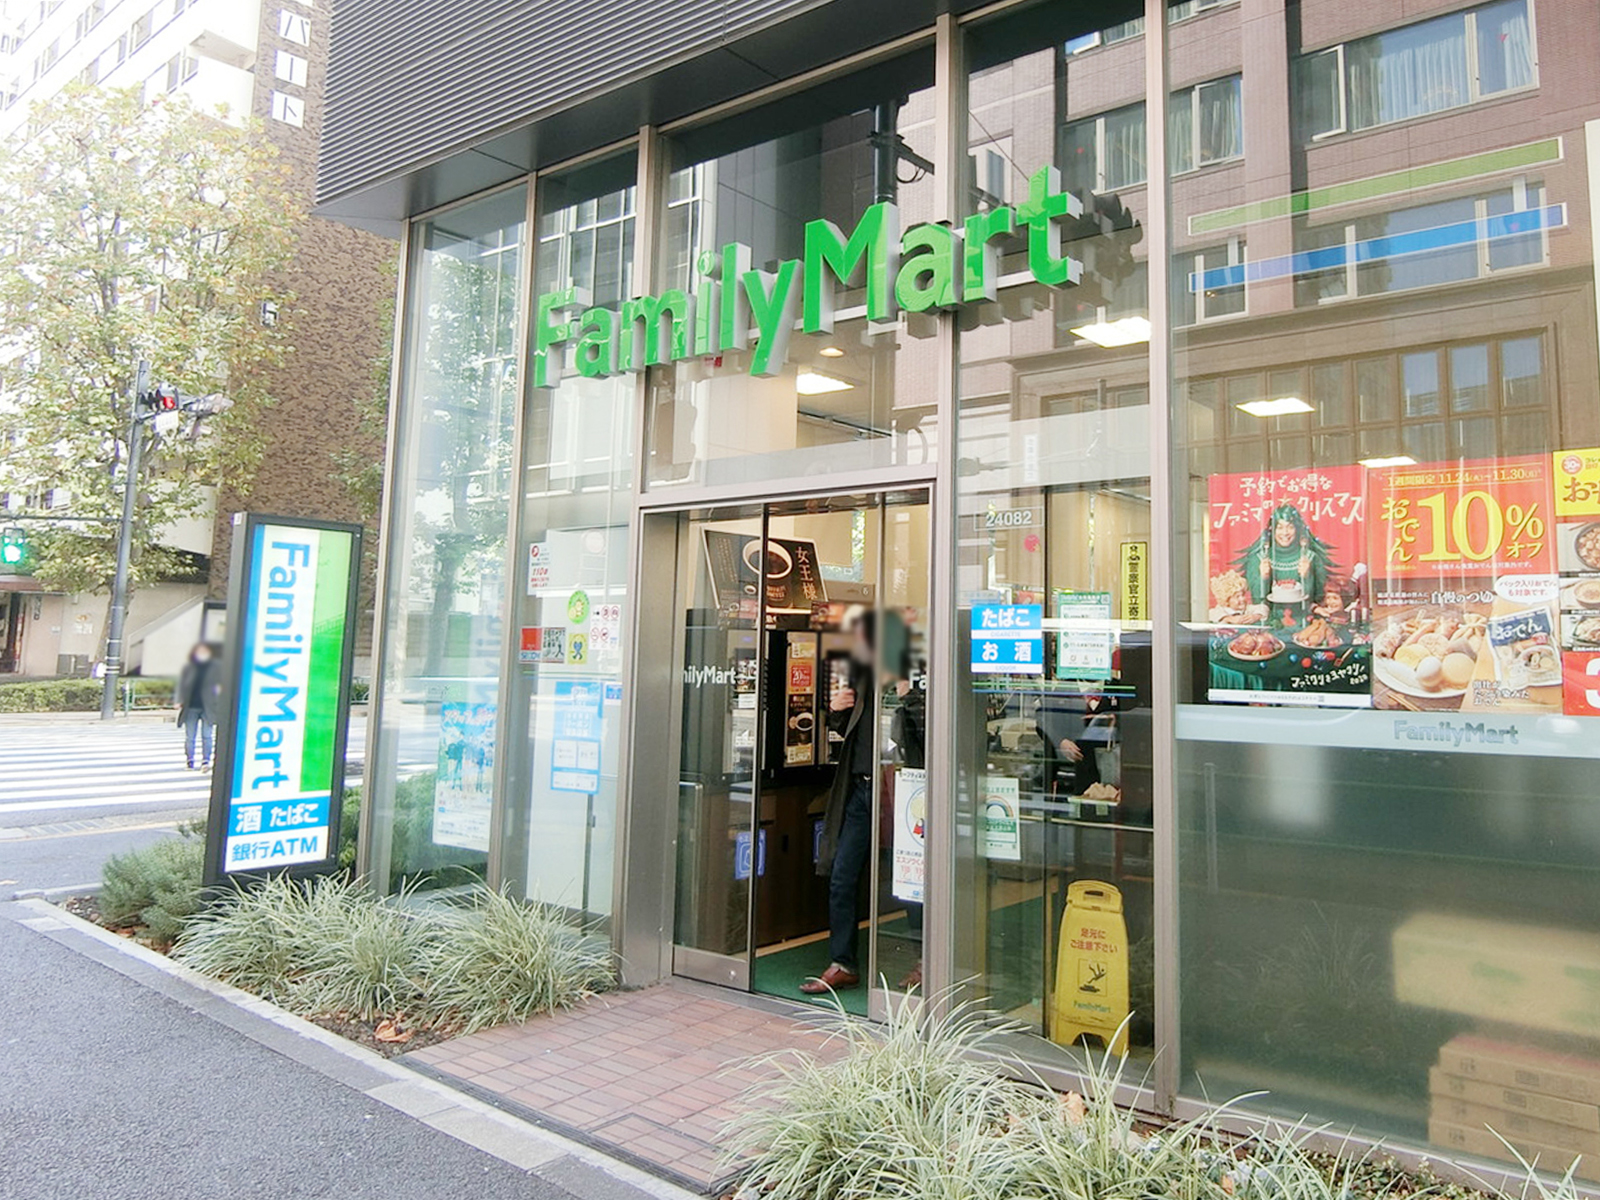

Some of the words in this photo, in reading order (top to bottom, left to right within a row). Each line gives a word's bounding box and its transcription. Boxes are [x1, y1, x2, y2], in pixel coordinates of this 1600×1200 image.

[533, 165, 1083, 389] FamilyMart
[1239, 473, 1333, 498] 予約でお得な
[1562, 476, 1600, 503] お
[986, 511, 1032, 528] 24082
[1381, 496, 1421, 563] おでん
[1506, 541, 1544, 559] オフ
[794, 545, 819, 601] 女王様
[981, 607, 1031, 628] たばこ
[1495, 618, 1544, 642] おでん
[251, 540, 311, 791] FamilyMart
[1393, 719, 1520, 747] FamilyMart
[234, 804, 264, 833] 酒
[268, 802, 320, 828] たばこ
[231, 835, 319, 863] 銀行ATM
[1080, 927, 1107, 940] 足元に
